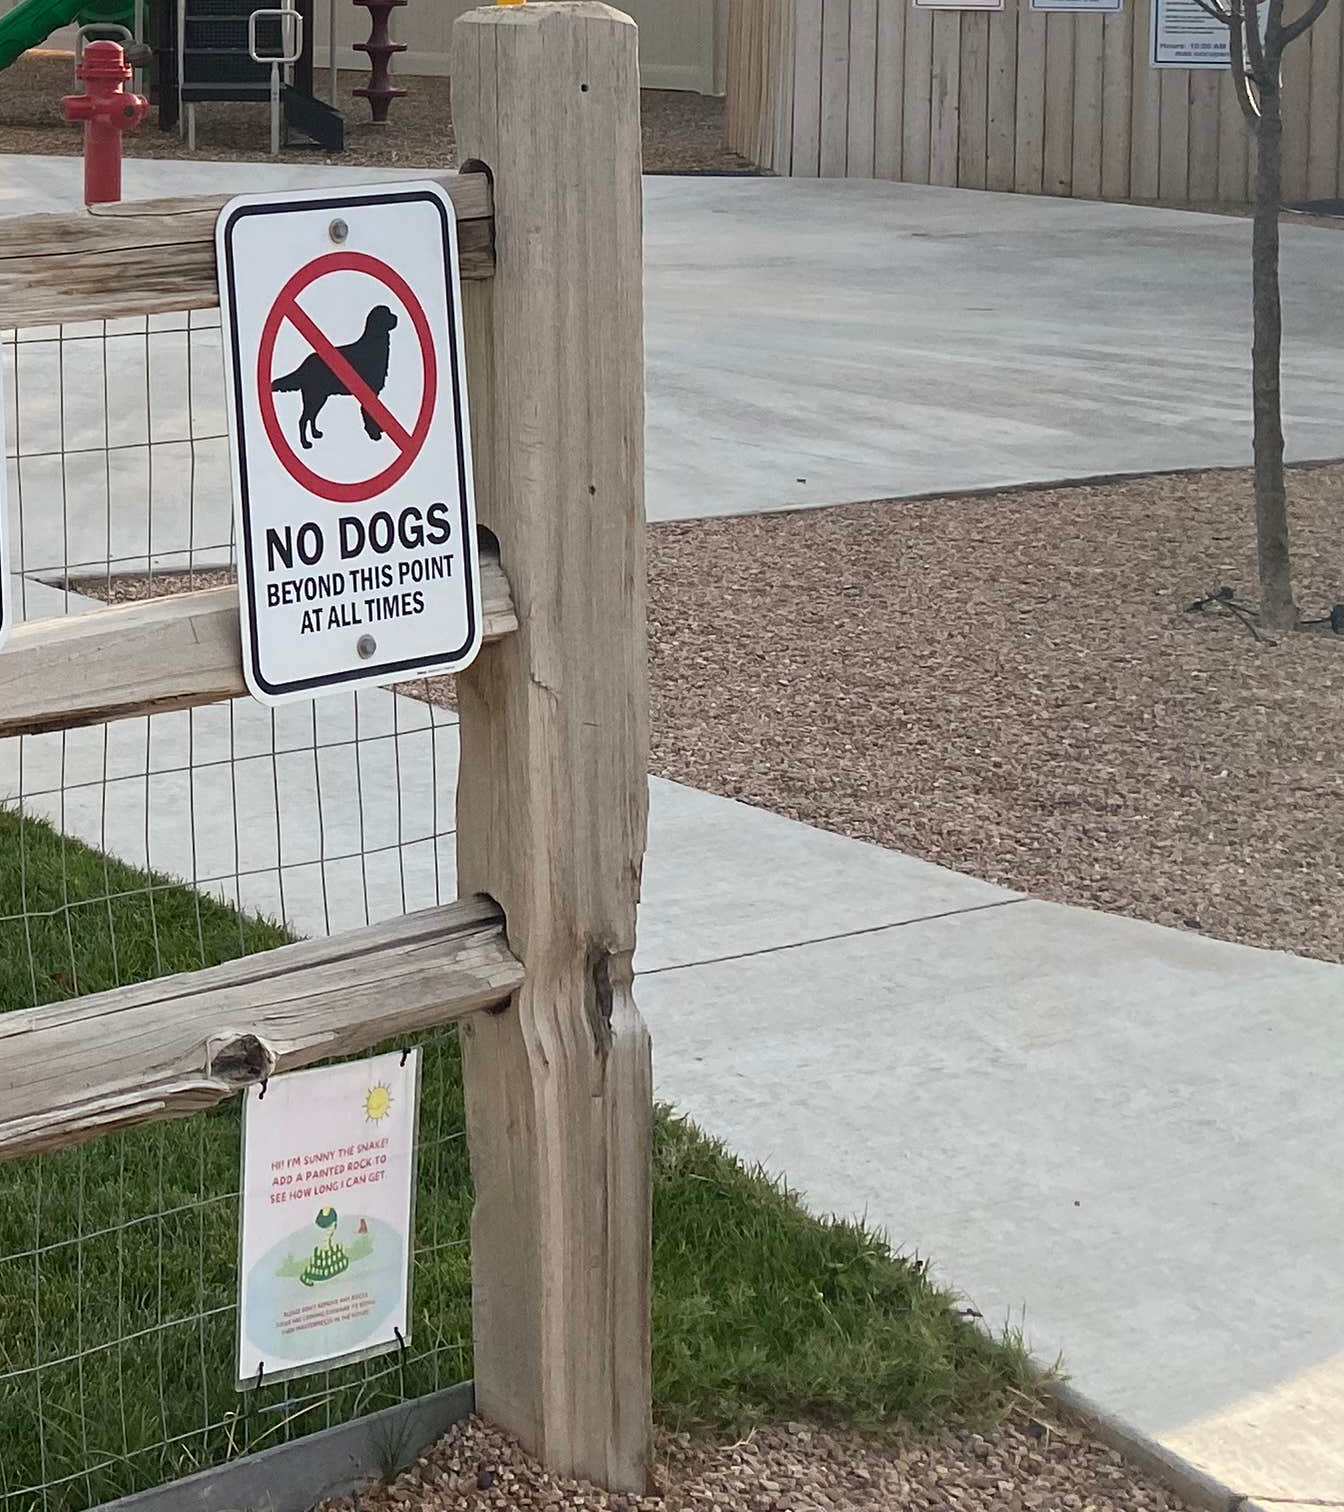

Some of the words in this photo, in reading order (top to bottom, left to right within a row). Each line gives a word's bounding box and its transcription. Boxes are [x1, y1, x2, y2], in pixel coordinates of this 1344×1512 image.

[266, 522, 324, 572] NO
[339, 502, 451, 559] DOGS
[267, 572, 346, 608] BEYOND
[349, 565, 393, 594] THIS
[398, 554, 454, 584] POINT
[300, 606, 325, 635] AT
[328, 600, 362, 630] ALL
[364, 590, 425, 625] TIMES
[272, 1175, 293, 1186] ADD
[295, 1173, 303, 1182] A
[305, 1165, 345, 1181] PAINTED
[347, 1158, 372, 1170] ROCK
[375, 1154, 387, 1165] TO
[287, 1156, 301, 1169] I'M
[304, 1150, 336, 1166] SUNNY
[338, 1145, 354, 1157] THE
[270, 1191, 286, 1204] SEE
[289, 1189, 311, 1200] HOW
[314, 1182, 340, 1196] LONG
[340, 1180, 344, 1189] I
[345, 1174, 367, 1188] CAN
[368, 1170, 385, 1183] GET
